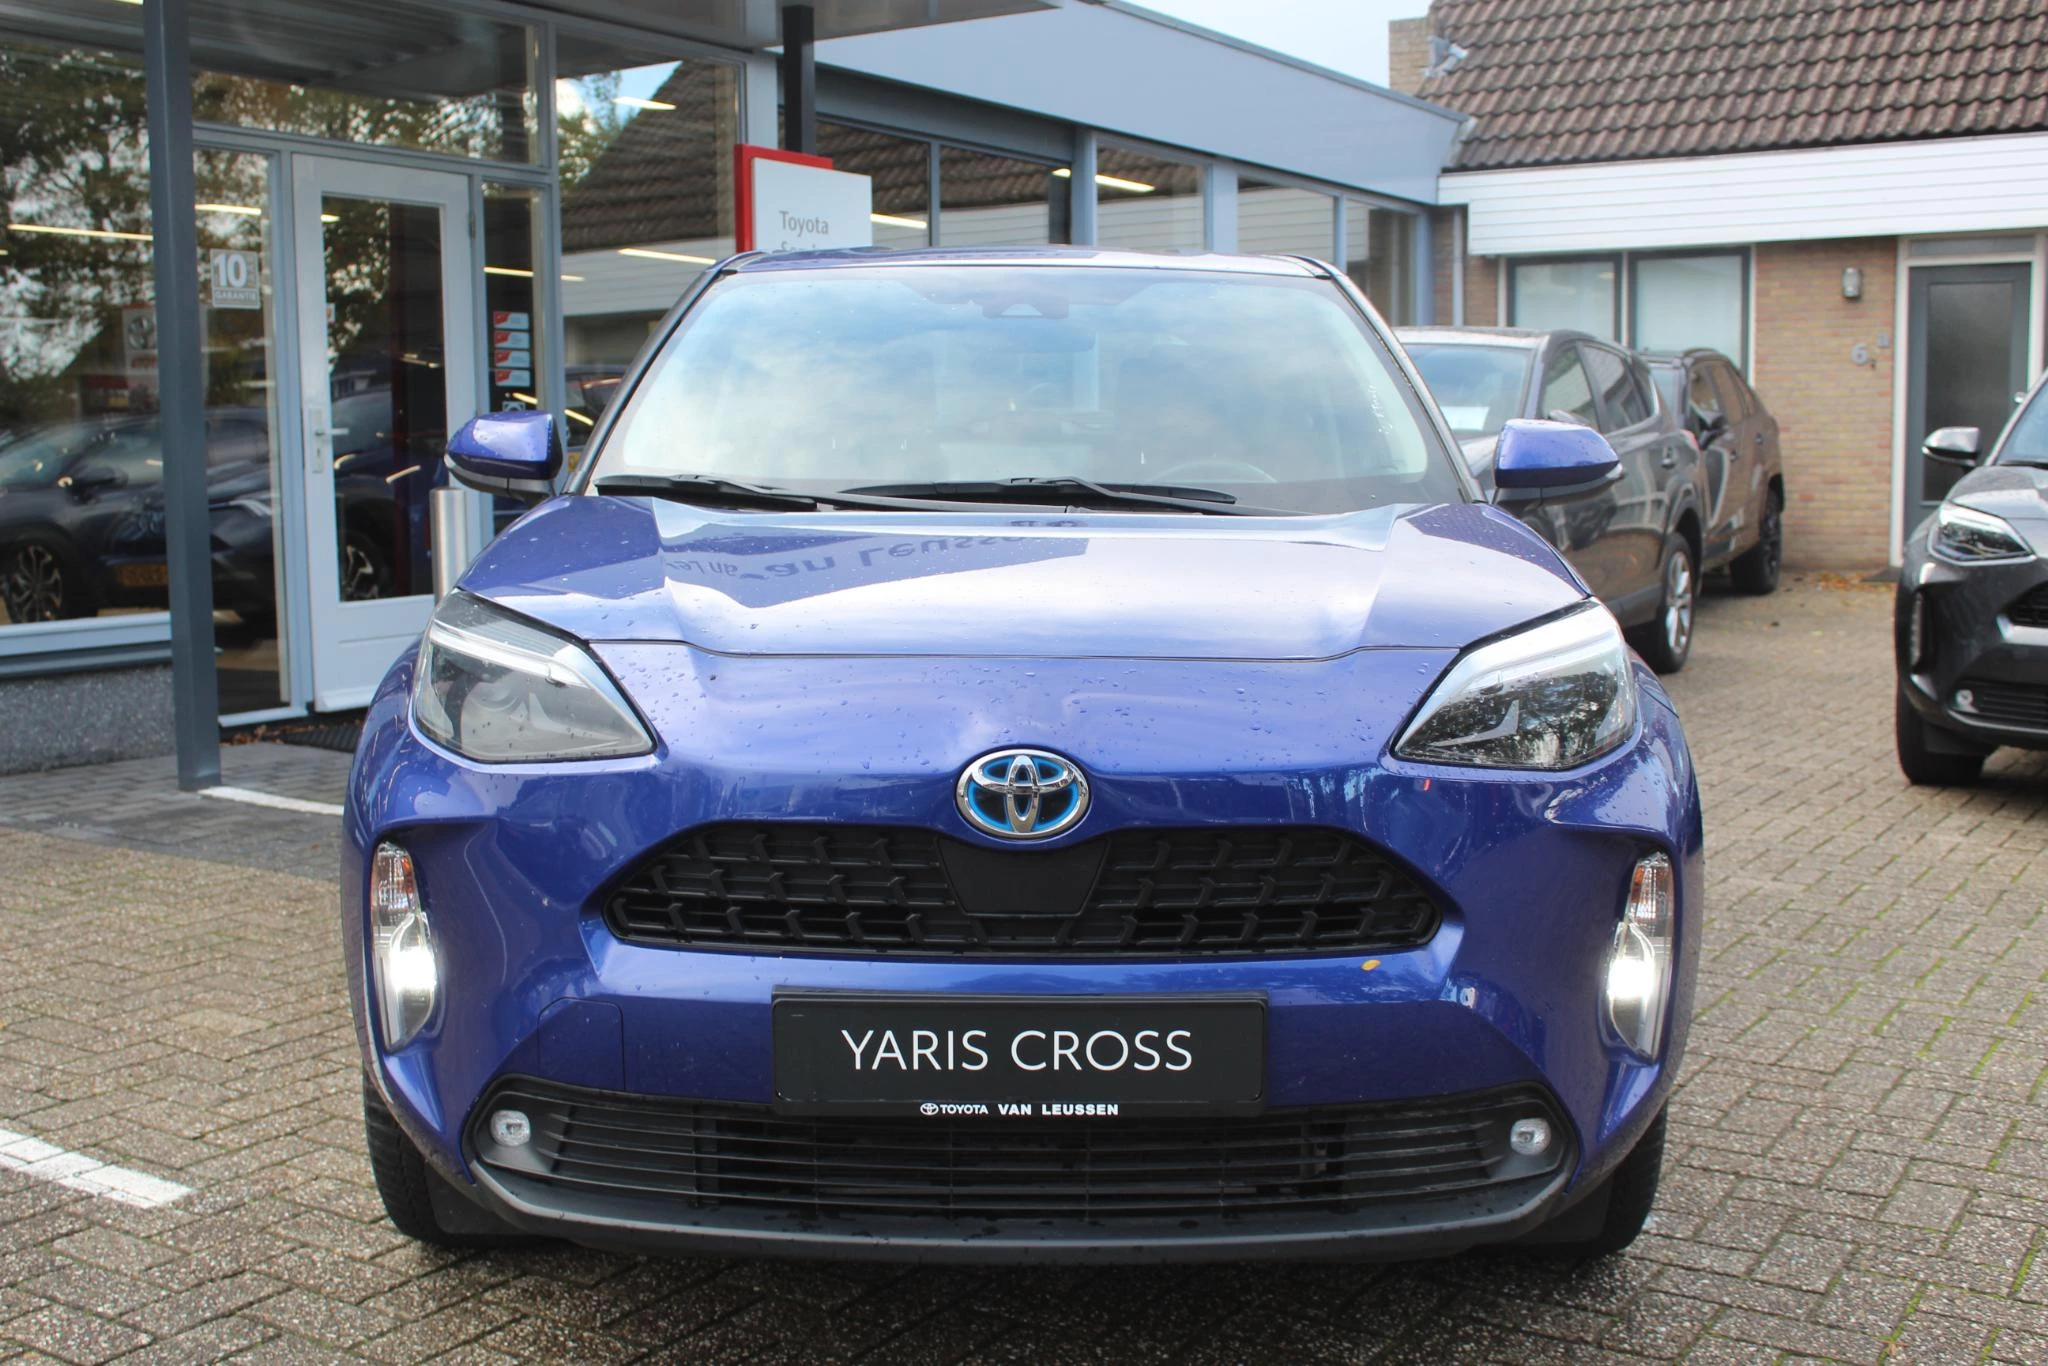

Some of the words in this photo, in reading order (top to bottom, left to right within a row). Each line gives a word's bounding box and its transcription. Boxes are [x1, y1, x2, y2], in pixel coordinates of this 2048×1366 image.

[779, 210, 829, 238] Toyota
[214, 253, 248, 289] 10
[841, 1029, 988, 1071] YARIS
[1011, 1029, 1193, 1071] CROSS
[940, 1103, 989, 1115] TOYOTA
[998, 1103, 1032, 1116] VAN
[1041, 1103, 1119, 1116] LEUSSEN
